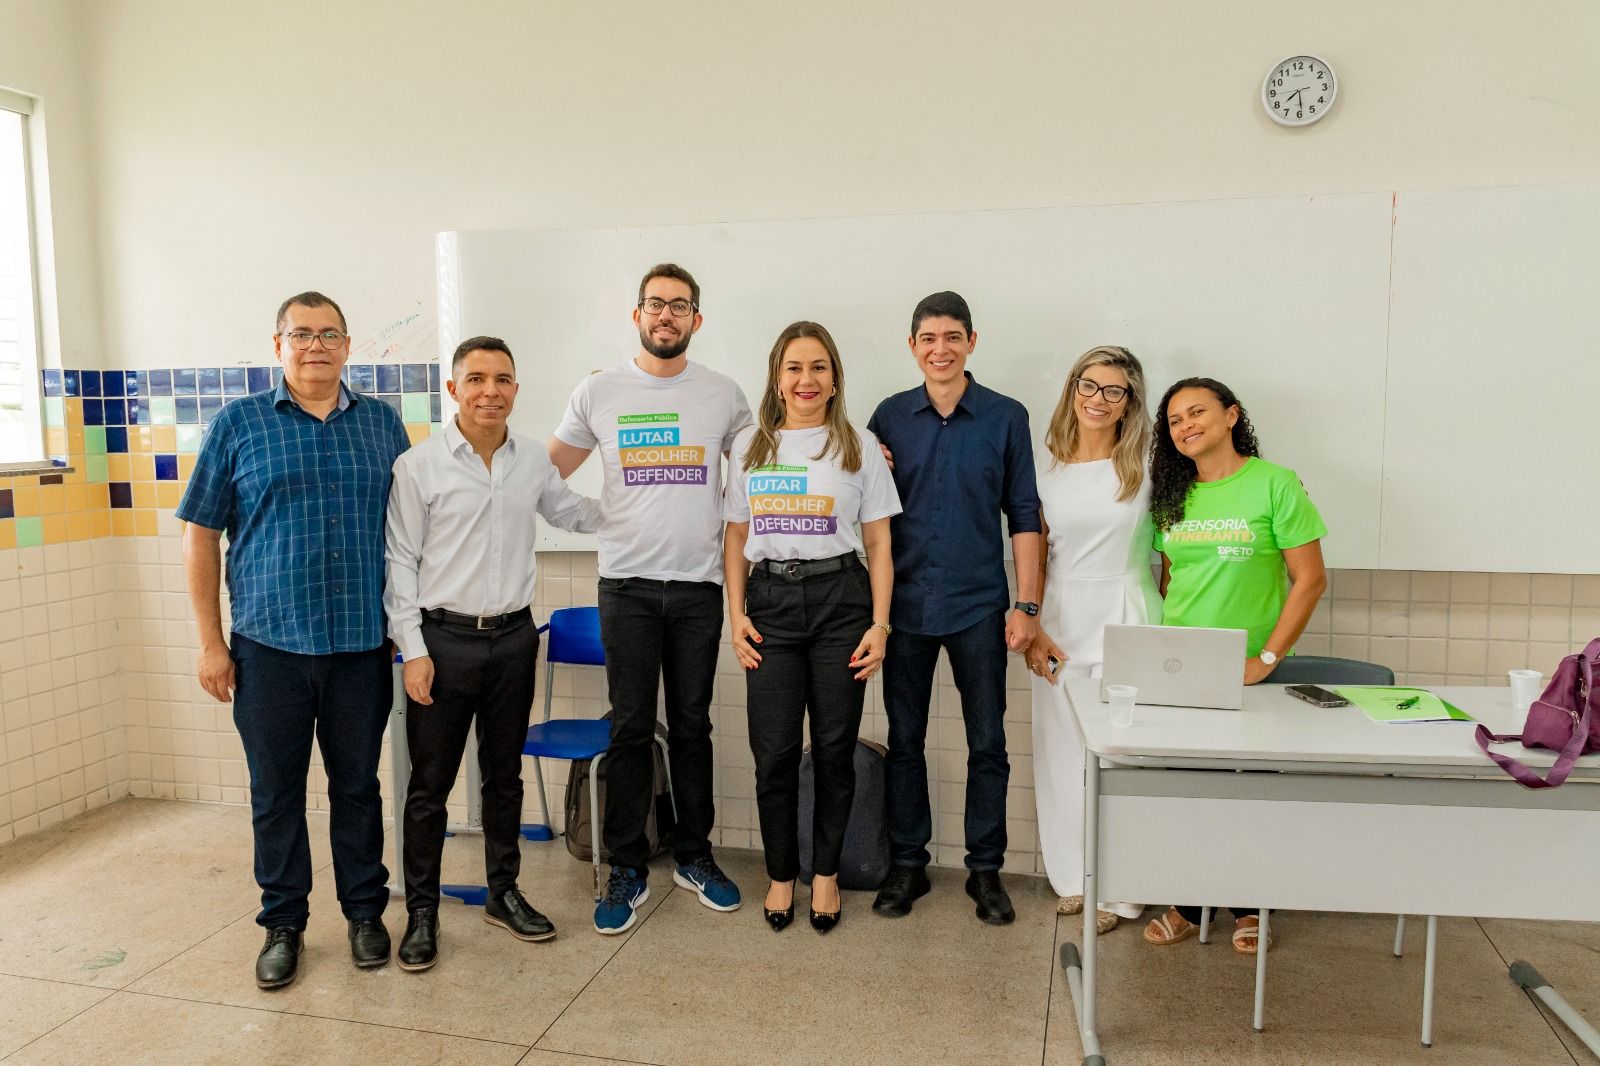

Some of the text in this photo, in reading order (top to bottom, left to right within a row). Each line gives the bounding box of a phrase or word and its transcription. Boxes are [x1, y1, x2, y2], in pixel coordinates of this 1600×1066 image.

[1293, 61, 1304, 70] 12
[1309, 64, 1314, 72] 1
[1279, 68, 1290, 77] 11
[1317, 70, 1324, 79] 2
[1272, 78, 1283, 87] 10
[1321, 83, 1328, 91] 3
[1269, 89, 1276, 98] 9
[1317, 96, 1324, 104] 4
[1274, 101, 1280, 109] 8
[1309, 105, 1315, 113] 5
[1283, 108, 1290, 117] 7
[1296, 110, 1303, 118] 6
[622, 431, 674, 445] LUTAR
[625, 449, 698, 464] ACOLHER
[627, 468, 703, 483] DEFENDER
[751, 479, 801, 492] LUTAR
[754, 498, 826, 512] ACOLHER
[755, 517, 829, 532] DEFENDER
